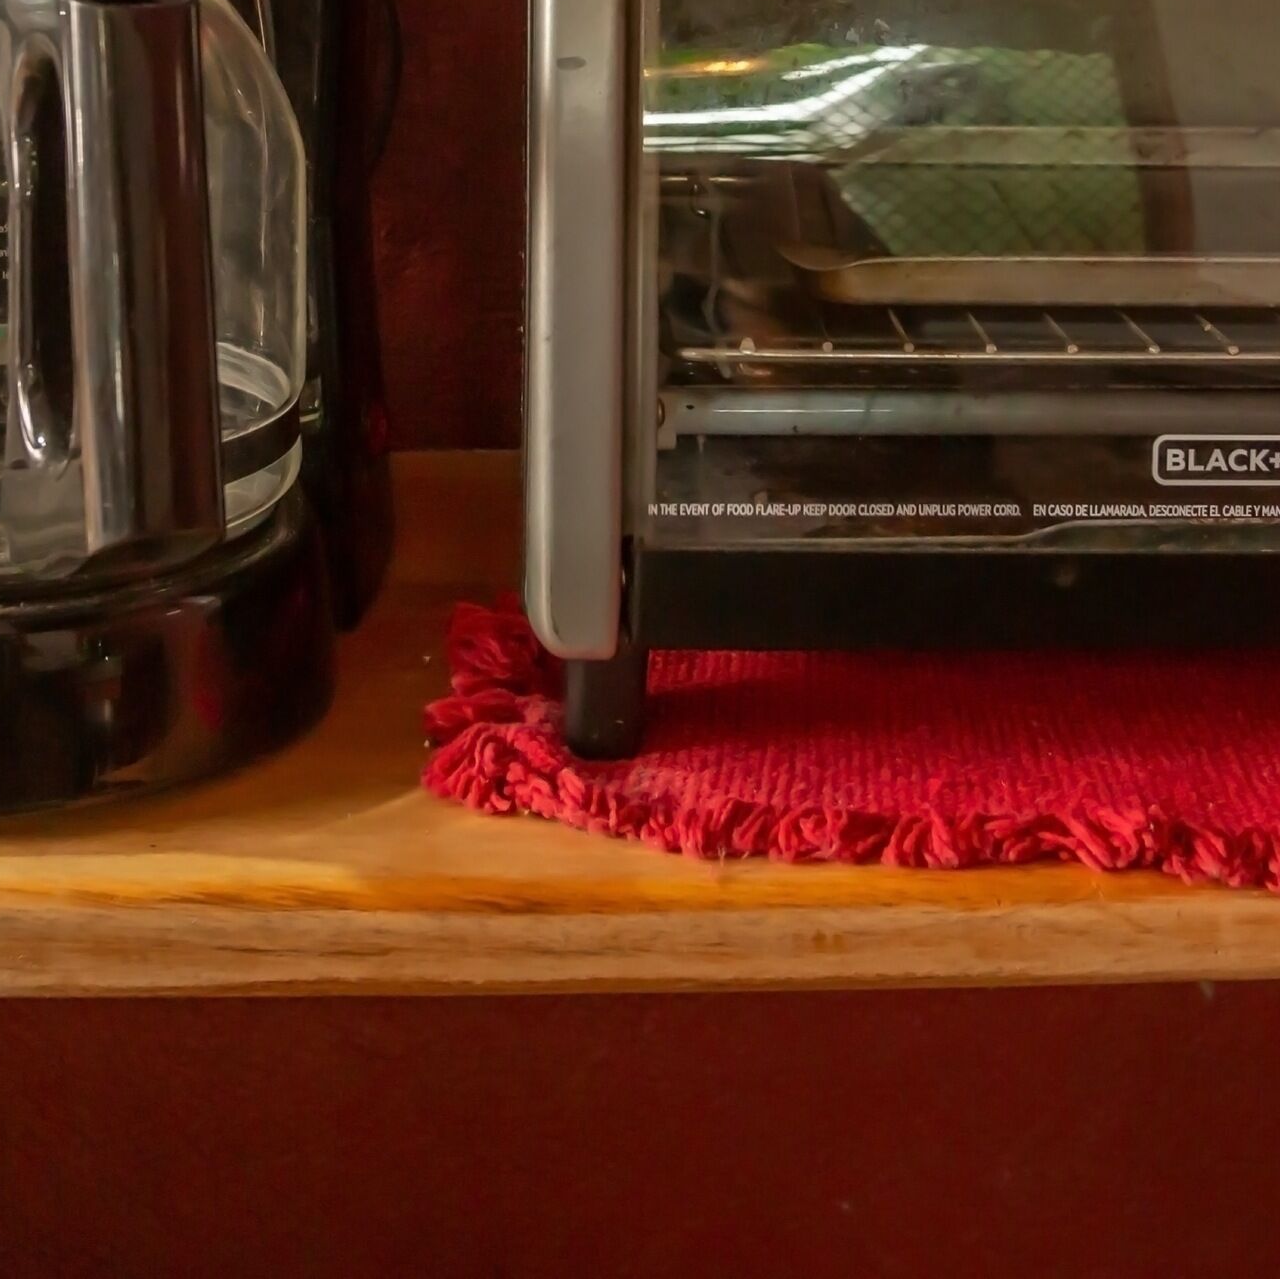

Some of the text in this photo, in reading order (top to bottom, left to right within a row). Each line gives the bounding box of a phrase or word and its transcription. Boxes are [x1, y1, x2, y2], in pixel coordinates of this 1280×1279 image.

[648, 503, 1021, 516] IN THE EVENT OF FOOD FLARE-UP KEEP DOOR CLOSED AND UNPLUG POWER CORD.
[1033, 504, 1046, 517] EN
[1048, 504, 1073, 517] CASO
[1075, 504, 1088, 517] DE
[1090, 504, 1147, 517] LLAMARADA,
[1149, 504, 1208, 517] DESCONECTE
[1209, 504, 1220, 517] EL
[1222, 505, 1252, 517] CABLE
[1253, 505, 1260, 517] Y
